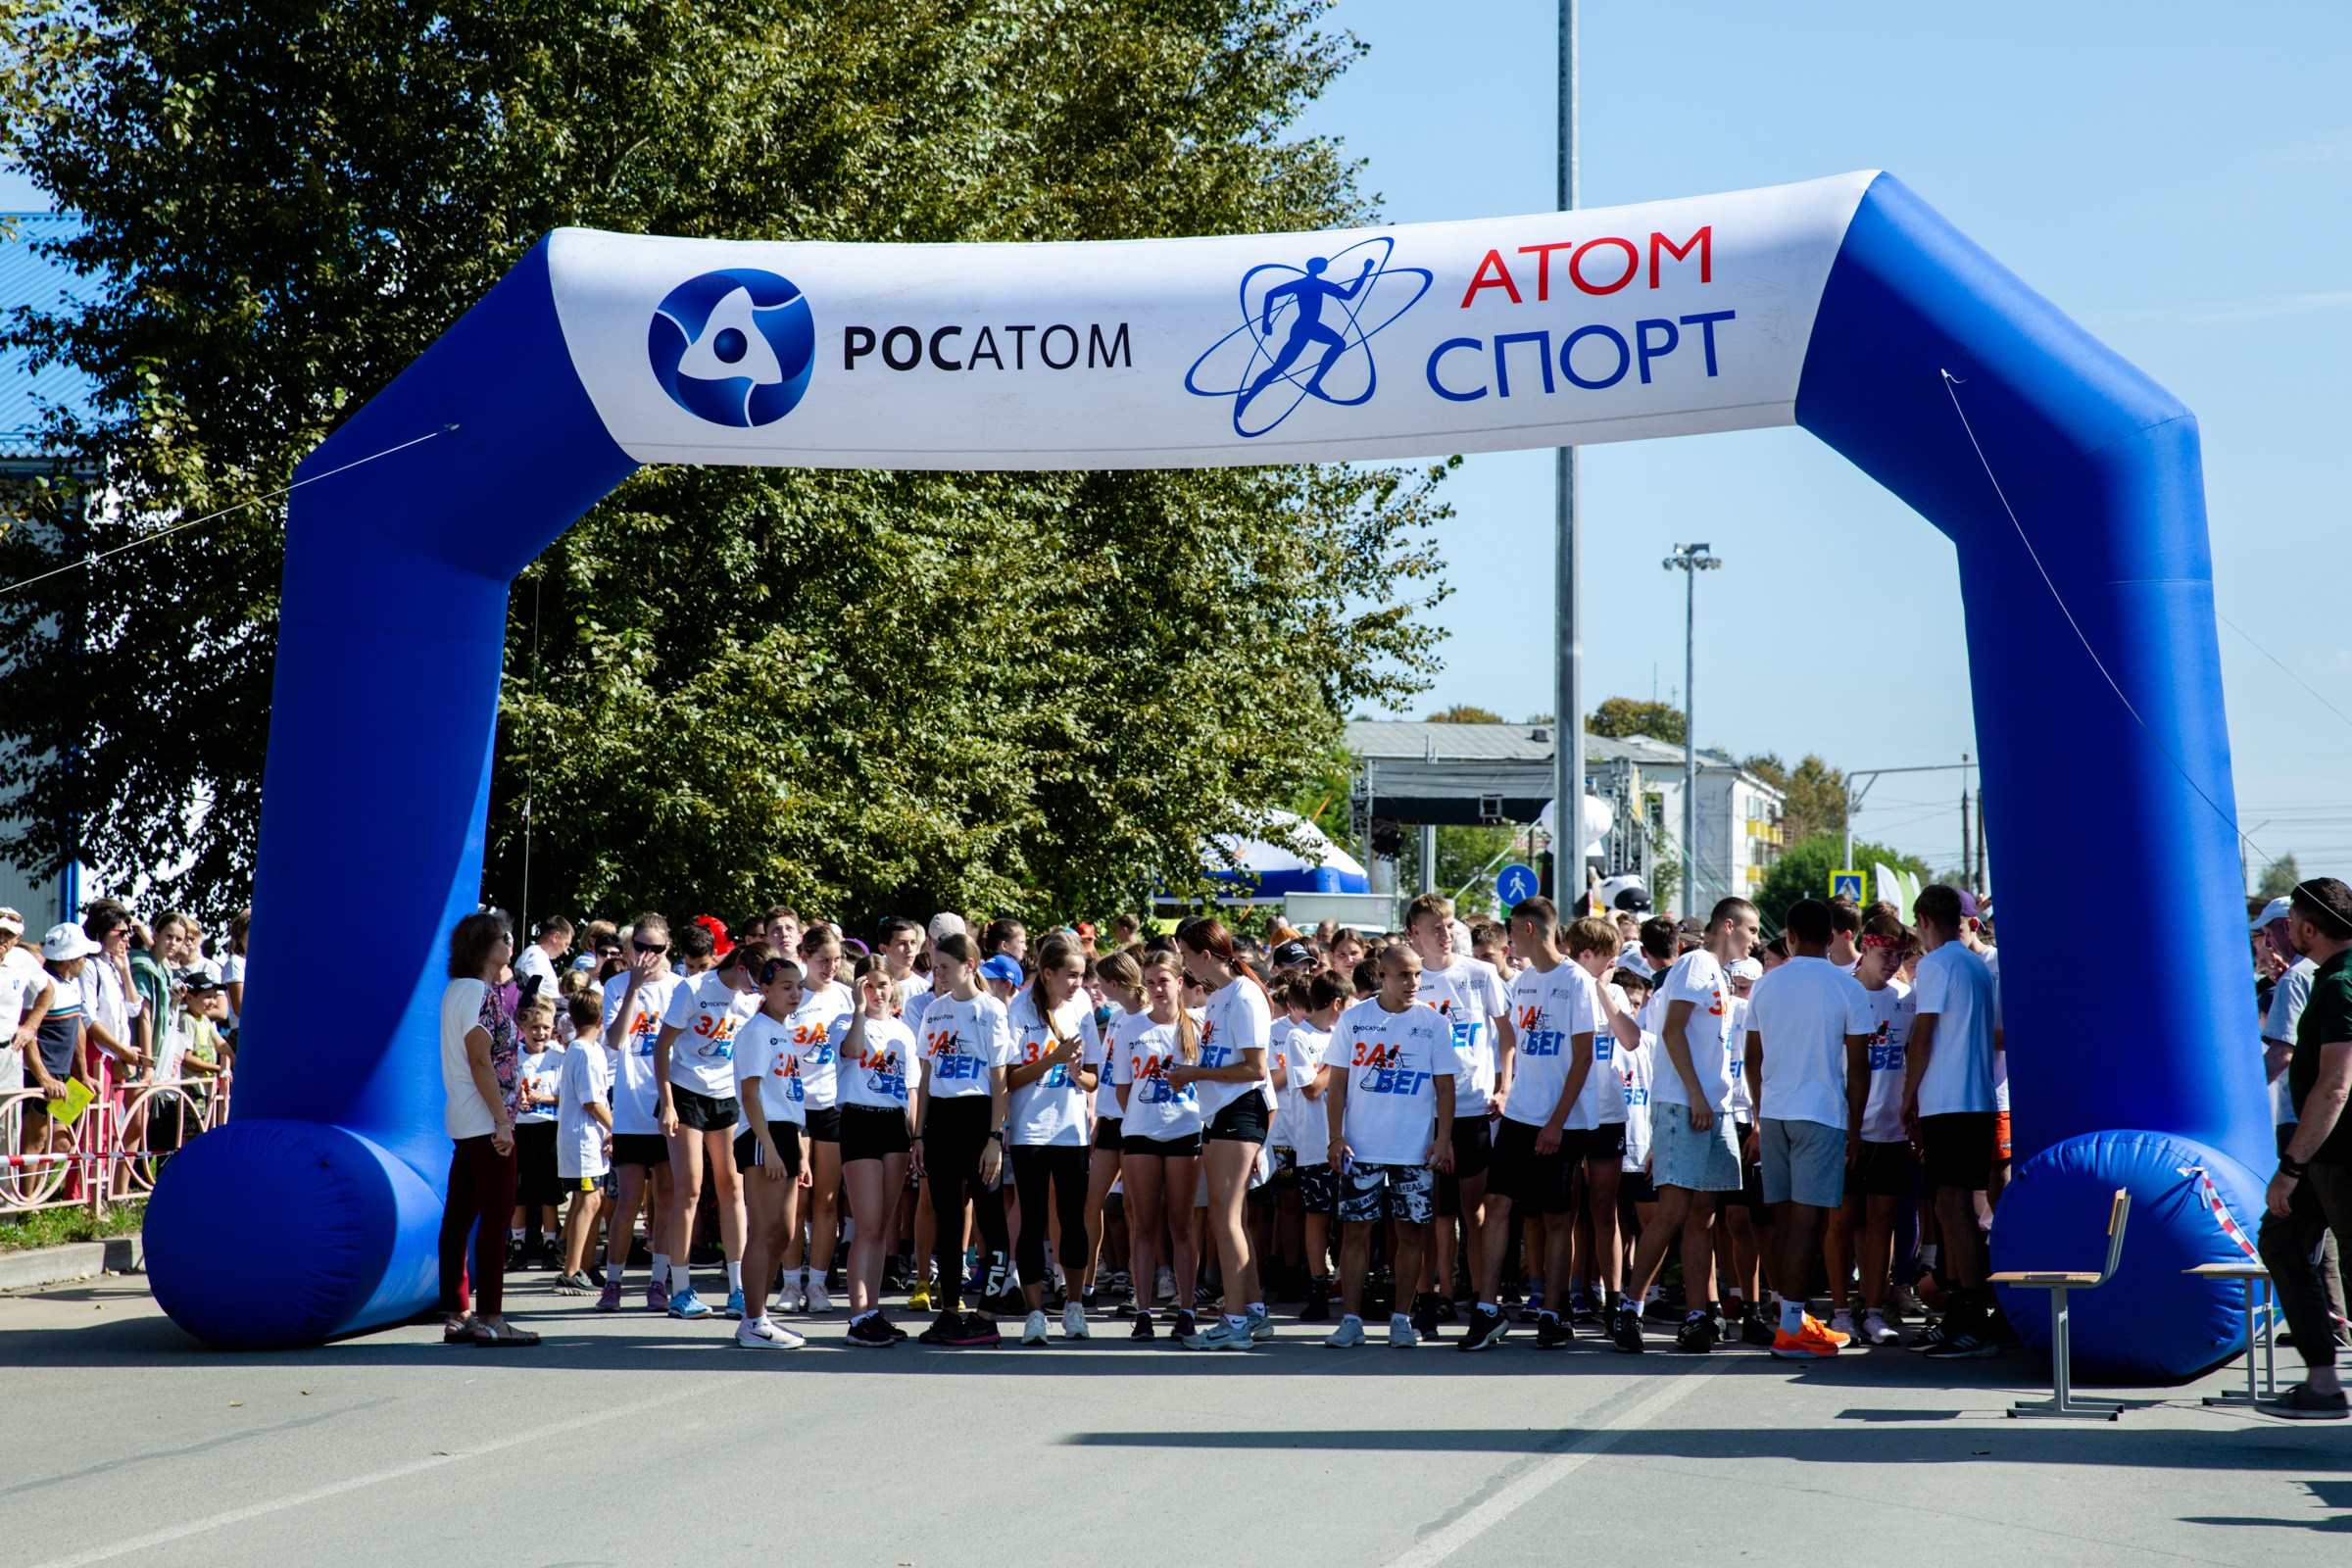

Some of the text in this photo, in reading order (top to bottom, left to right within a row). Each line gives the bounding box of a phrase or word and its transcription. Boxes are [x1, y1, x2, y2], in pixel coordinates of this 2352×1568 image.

[1460, 225, 1712, 309] АТОМ
[844, 322, 1132, 370] РОСАТОМ
[1426, 310, 1736, 402] СПОРТ
[1452, 1022, 1483, 1048] ЕГ
[1526, 1032, 1566, 1055] БЕГ
[940, 1055, 988, 1080] БЕГ
[1351, 1042, 1400, 1068] ЗА!
[1375, 1070, 1431, 1096] БЕГ
[986, 1250, 1007, 1297] FILA
